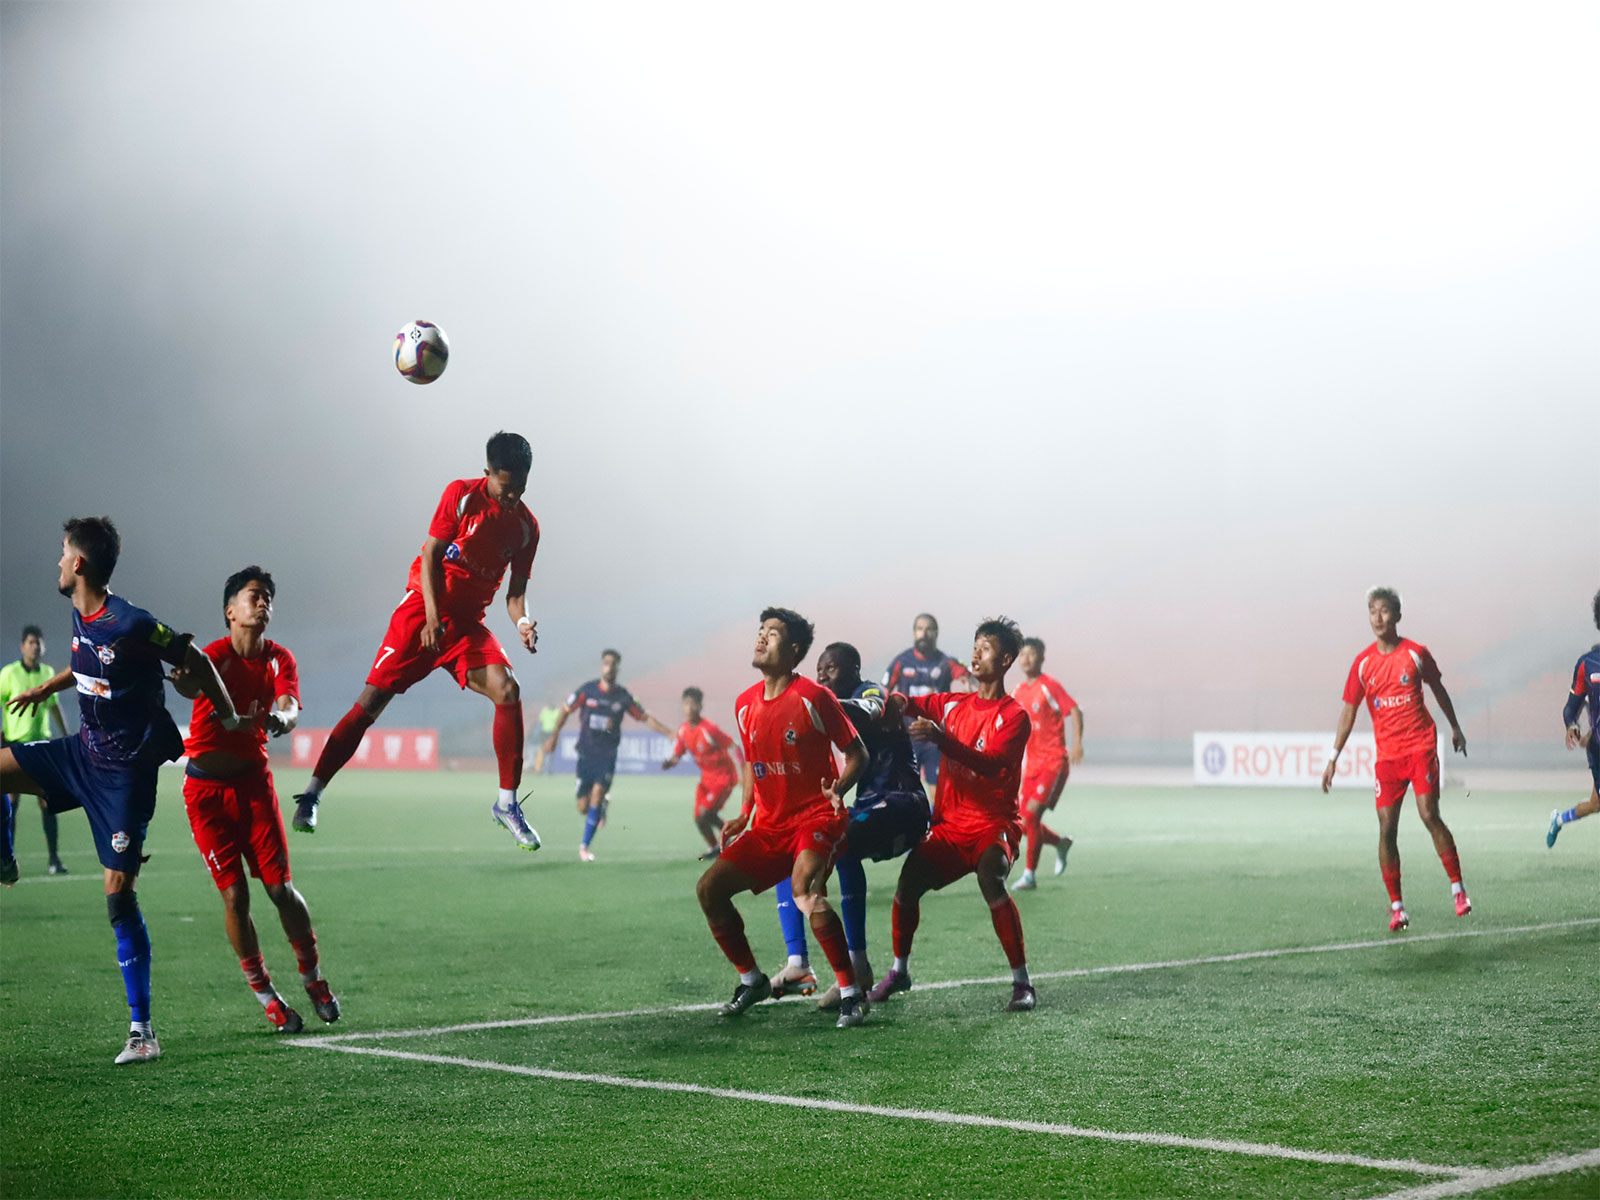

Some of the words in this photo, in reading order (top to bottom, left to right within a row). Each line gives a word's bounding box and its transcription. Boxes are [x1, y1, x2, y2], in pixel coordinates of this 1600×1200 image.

[375, 646, 395, 669] 7
[1233, 744, 1323, 776] ROYTE
[1335, 745, 1373, 776] GR
